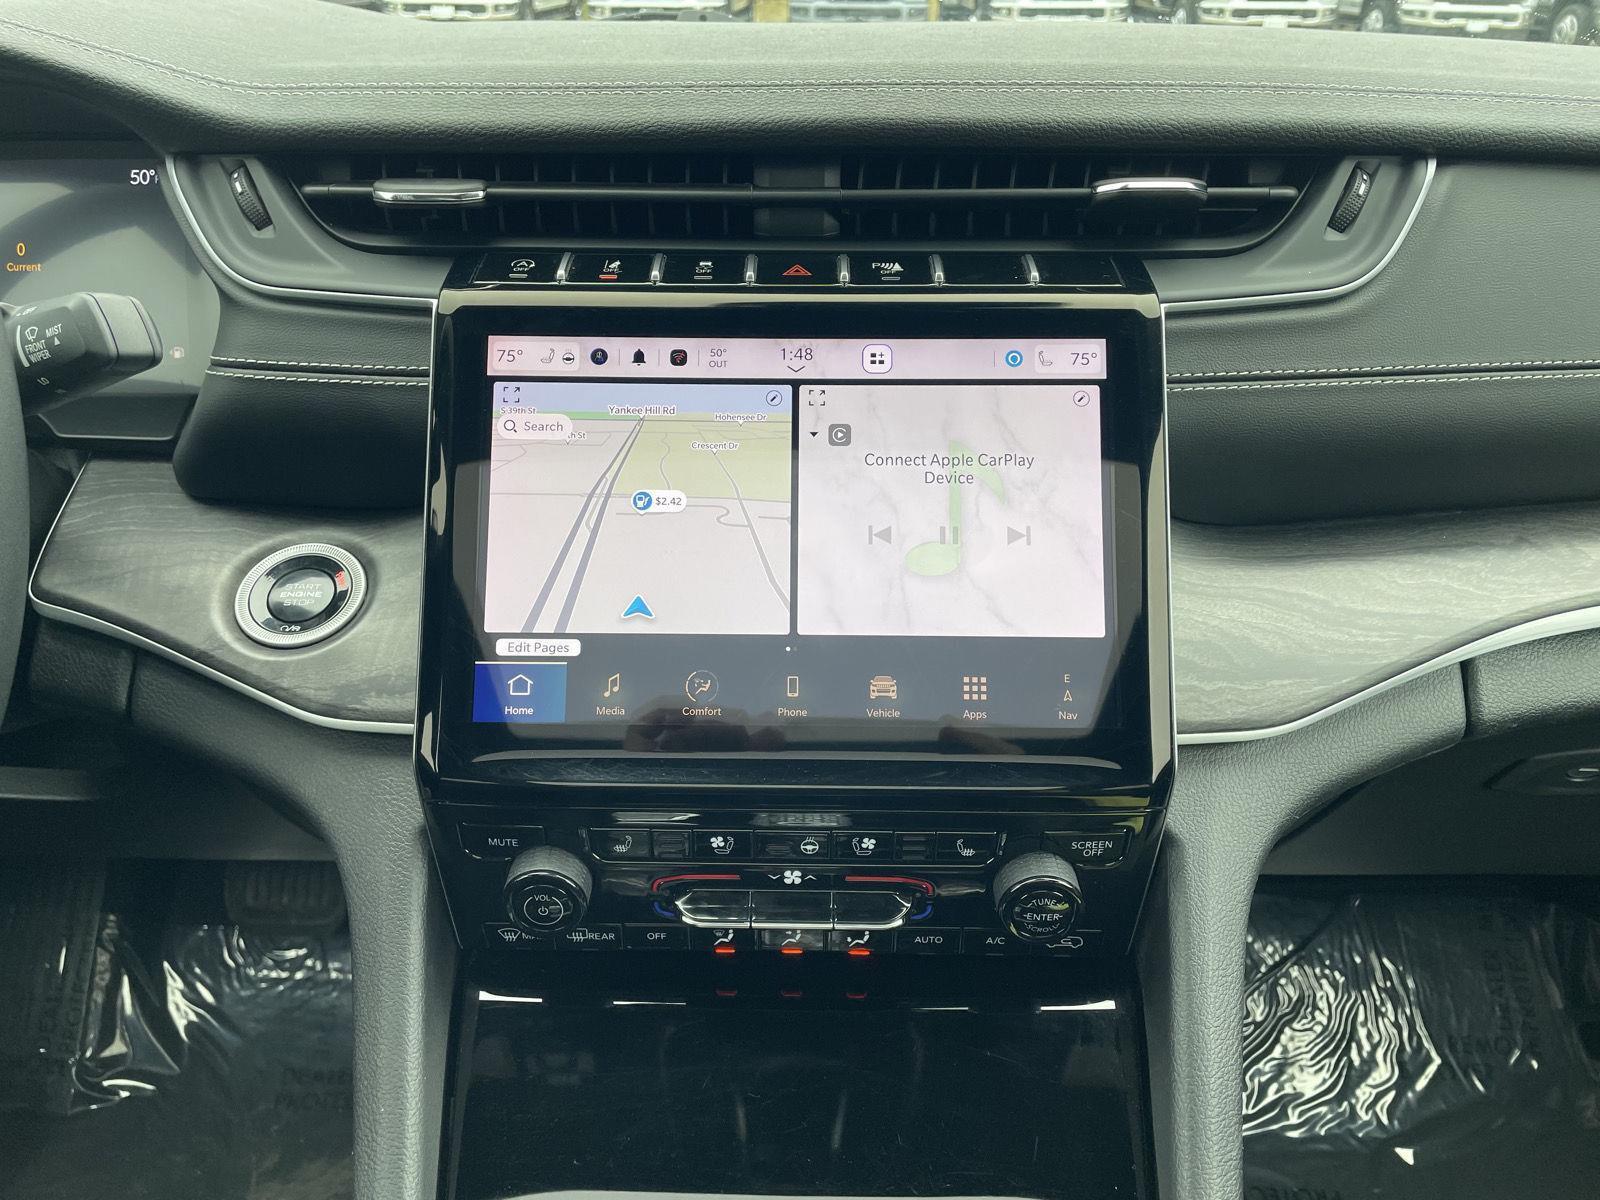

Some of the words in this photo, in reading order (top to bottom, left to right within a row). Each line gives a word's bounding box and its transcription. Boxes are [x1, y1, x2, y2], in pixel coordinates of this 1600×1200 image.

[16, 243, 26, 257] 0
[6, 262, 42, 272] Current
[45, 323, 62, 338] MIST
[24, 339, 47, 354] FRONT
[28, 349, 52, 363] WIPER
[496, 349, 523, 363] 75°
[709, 348, 727, 357] 50°
[780, 347, 814, 361] 1:48
[708, 360, 728, 368] OUT
[1070, 352, 1098, 366] 75°
[608, 405, 643, 415] Yankee
[645, 405, 661, 415] Hill
[662, 405, 676, 415] Rd
[715, 413, 755, 422] Hohensee
[757, 413, 767, 421] Dr
[524, 421, 564, 432] Search
[691, 441, 727, 449] Crescent
[728, 441, 739, 449] Dr
[864, 453, 926, 467] Connect
[930, 453, 974, 470] Apple
[978, 453, 1035, 470] CarPlay
[924, 471, 974, 485] Device
[655, 495, 682, 507] $2.42
[507, 642, 531, 653] Edit
[534, 642, 570, 655] Pages
[504, 706, 534, 715] Home
[596, 706, 625, 716] Media
[682, 706, 722, 716] Comfort
[777, 707, 808, 717] Phone
[866, 708, 900, 718] Vehicle
[963, 709, 987, 721] Apps
[1058, 710, 1078, 720] Nav
[488, 837, 519, 847] MUTE
[1071, 840, 1113, 850] SCREEN
[1083, 849, 1104, 857] OFF
[534, 894, 551, 902] VOL
[1032, 898, 1057, 907] TUNE
[1026, 912, 1060, 921] ENTER
[588, 932, 616, 941] REAR
[646, 932, 667, 941] OFF
[914, 935, 943, 944] AUTO
[985, 935, 1005, 945] A/C
